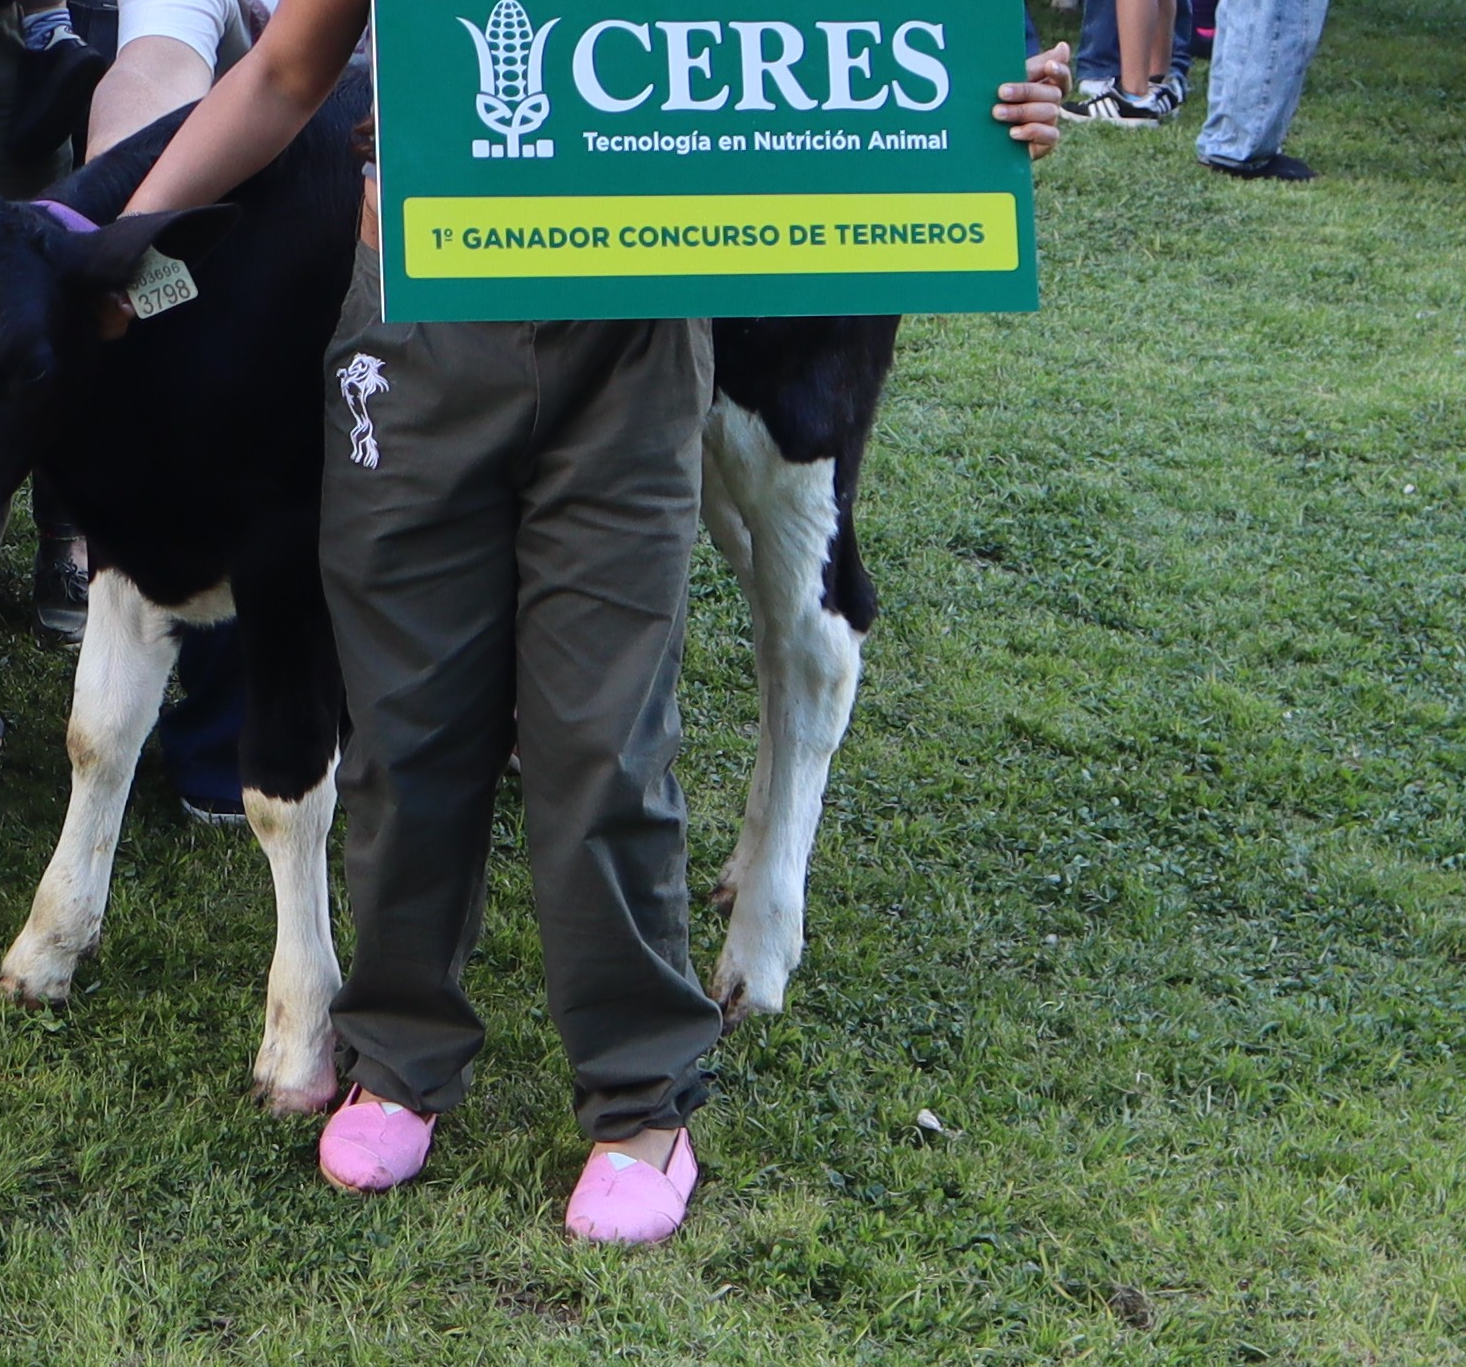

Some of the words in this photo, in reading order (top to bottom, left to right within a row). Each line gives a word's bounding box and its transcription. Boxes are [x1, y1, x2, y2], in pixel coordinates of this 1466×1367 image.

[572, 19, 950, 113] CERES
[583, 130, 712, 155] Tecnología
[718, 136, 746, 152] en
[754, 130, 861, 151] Nutrición
[868, 130, 948, 151] Animal
[431, 228, 454, 250] 1º
[462, 227, 610, 250] GANADOR
[618, 224, 780, 248] CONCURSO
[789, 224, 827, 247] DE
[838, 221, 986, 246] TERNEROS
[138, 278, 191, 314] 3798
